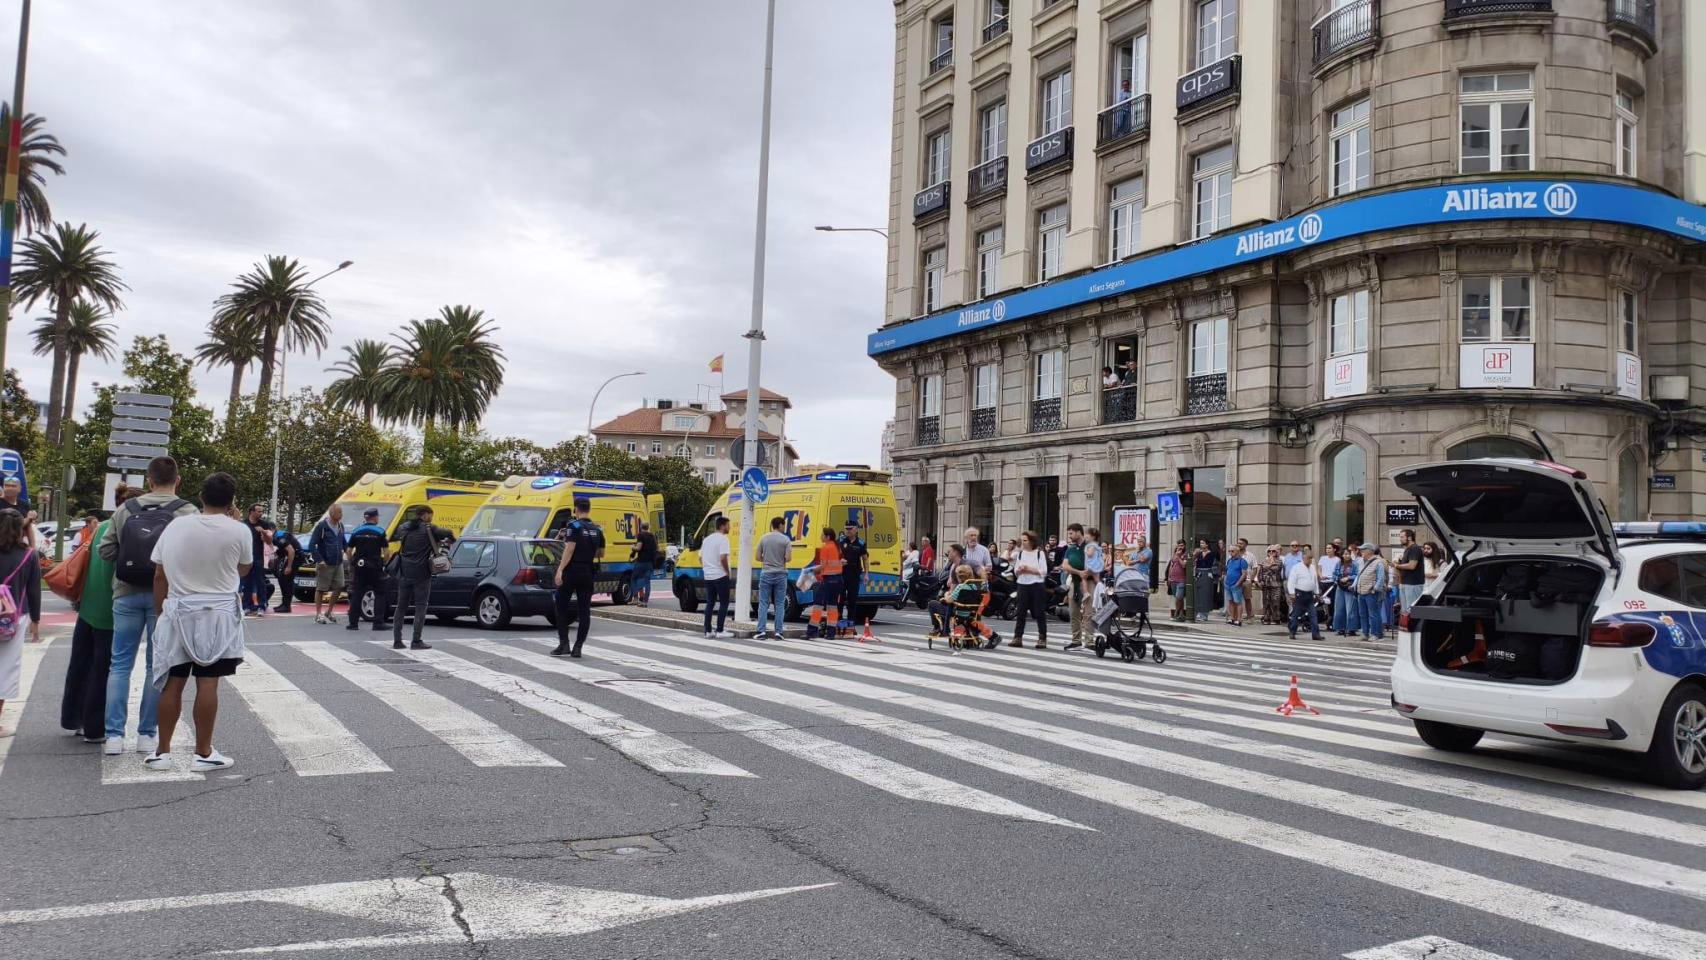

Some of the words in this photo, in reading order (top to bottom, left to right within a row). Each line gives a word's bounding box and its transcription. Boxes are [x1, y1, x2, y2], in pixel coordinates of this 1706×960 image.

[1182, 66, 1224, 93] aps
[1030, 135, 1061, 158] aps
[917, 188, 940, 206] aps
[1442, 187, 1537, 213] Allianz
[1235, 226, 1295, 256] Allianz
[958, 308, 991, 328] Allianz
[840, 495, 886, 504] AMBULANCIA
[1160, 496, 1174, 517] P
[1119, 513, 1147, 532] BURGERS
[1389, 508, 1416, 518] aps
[873, 532, 893, 543] SVB
[1623, 600, 1647, 610] 092
